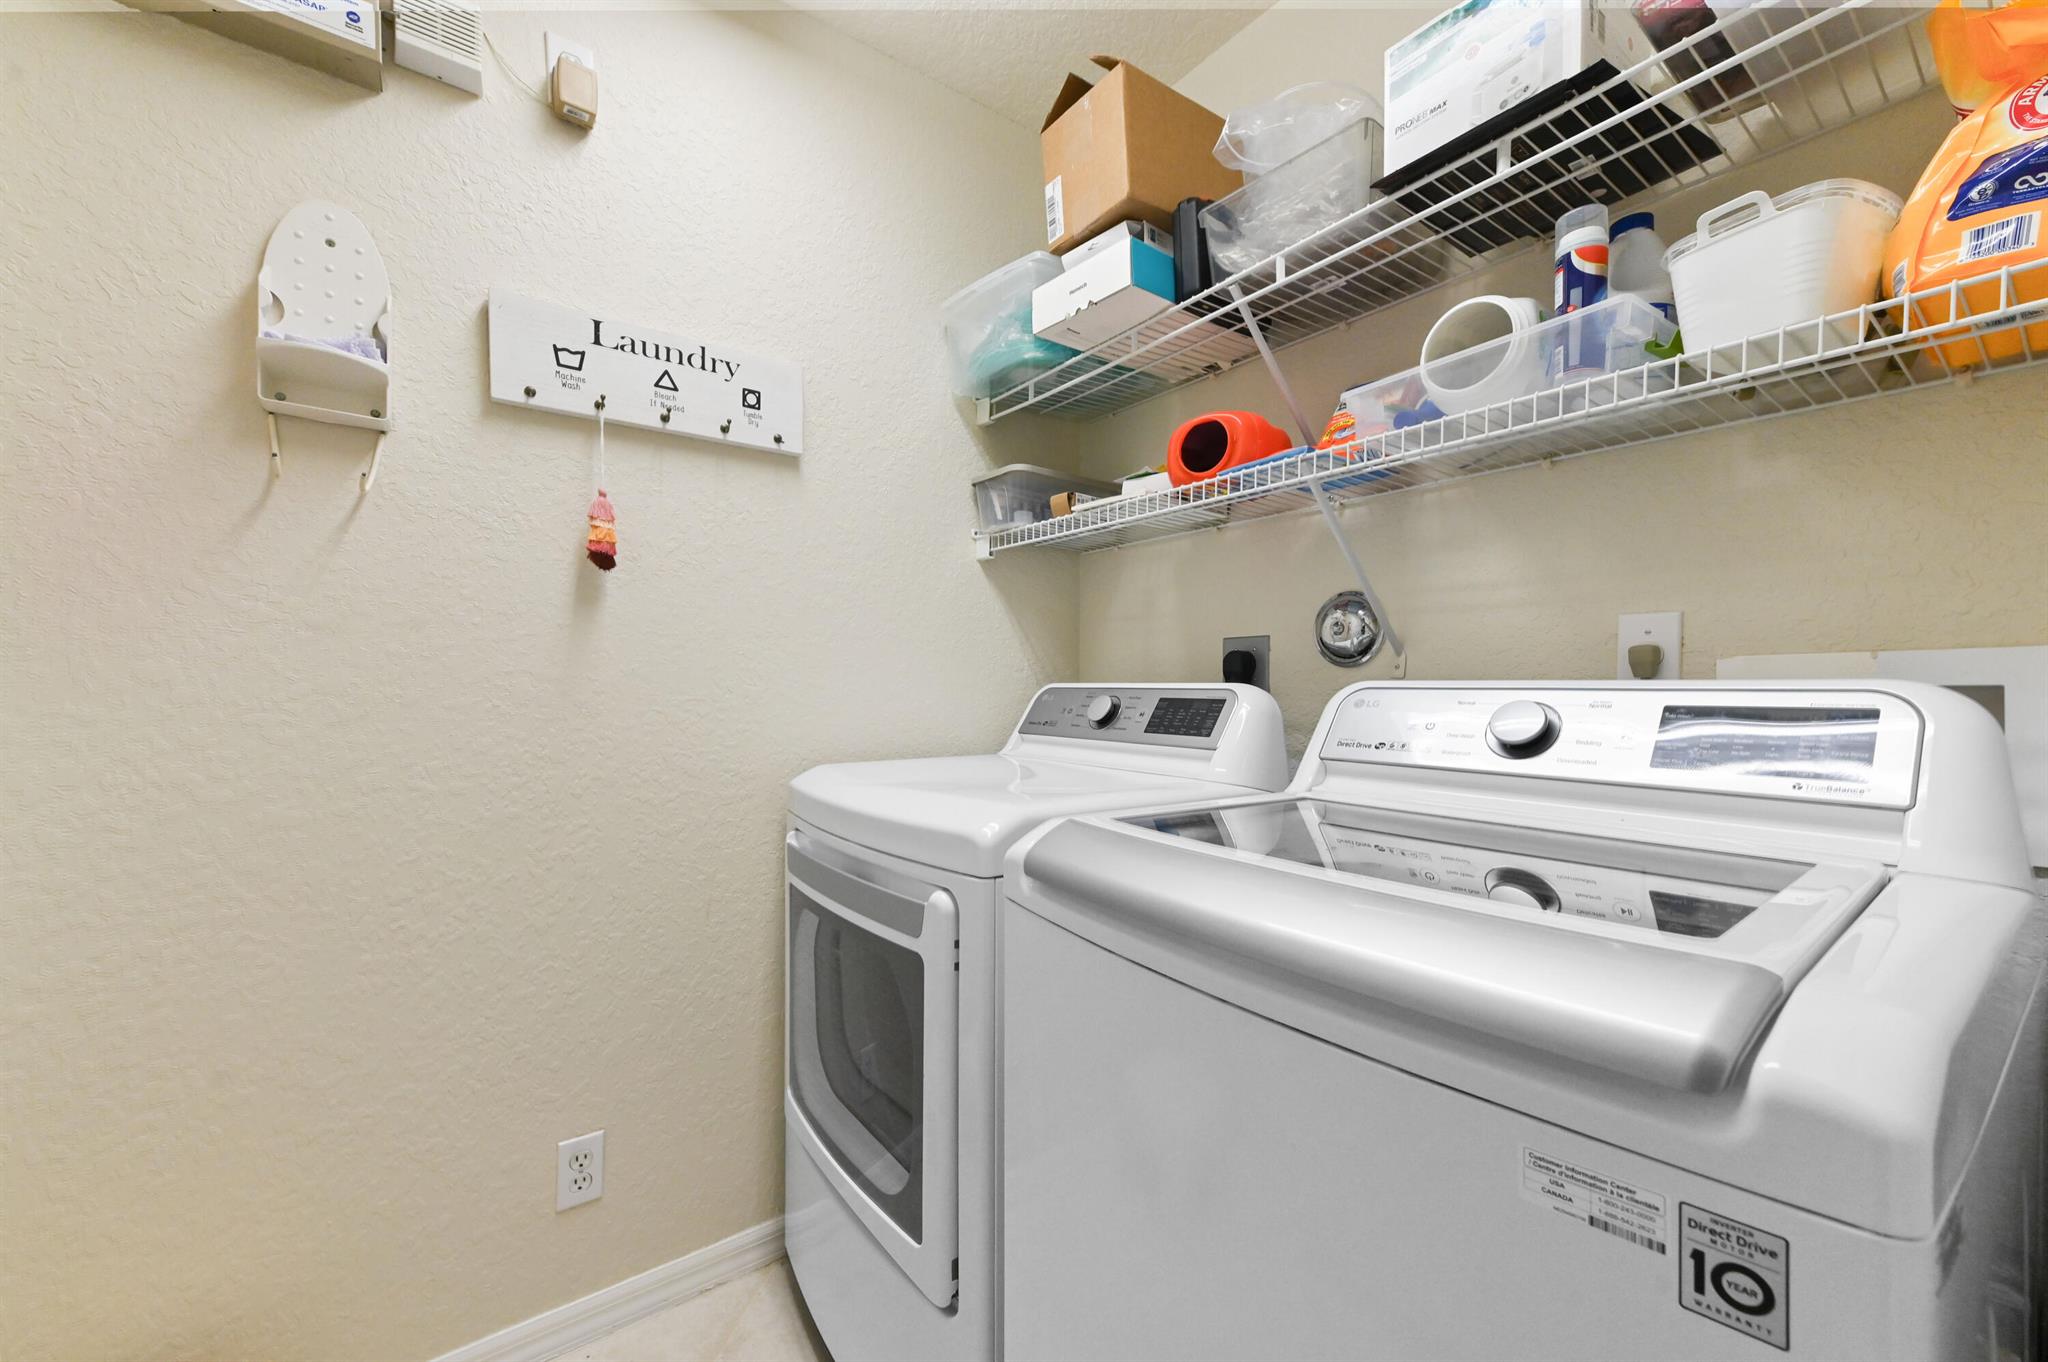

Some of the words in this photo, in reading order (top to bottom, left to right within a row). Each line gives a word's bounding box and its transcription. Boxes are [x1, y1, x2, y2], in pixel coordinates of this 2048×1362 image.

[1429, 99, 1448, 115] MAX
[591, 318, 740, 382] Laundry
[555, 370, 586, 384] Machine
[561, 380, 581, 391] Wash
[654, 391, 677, 402] Bleach
[650, 399, 658, 407] If
[660, 400, 685, 413] Needed
[743, 410, 763, 420] Tumble
[748, 419, 759, 429] Dry
[1366, 700, 1380, 708] LG
[1337, 740, 1355, 748] Direct
[1528, 1151, 1563, 1169] Customer
[1610, 1181, 1637, 1195] Center
[1532, 1160, 1556, 1174] Centre
[1616, 1190, 1624, 1199] la
[1548, 1178, 1566, 1189] USA
[1541, 1186, 1574, 1204] CANADA
[1710, 1217, 1754, 1238] INVERTER
[1687, 1217, 1733, 1243] Direct
[1736, 1235, 1779, 1260] Drive
[1709, 1237, 1755, 1259] MOTOR
[1689, 1247, 1776, 1316] 10
[1726, 1279, 1759, 1300] YEAR
[1694, 1298, 1772, 1336] WARRANTY
